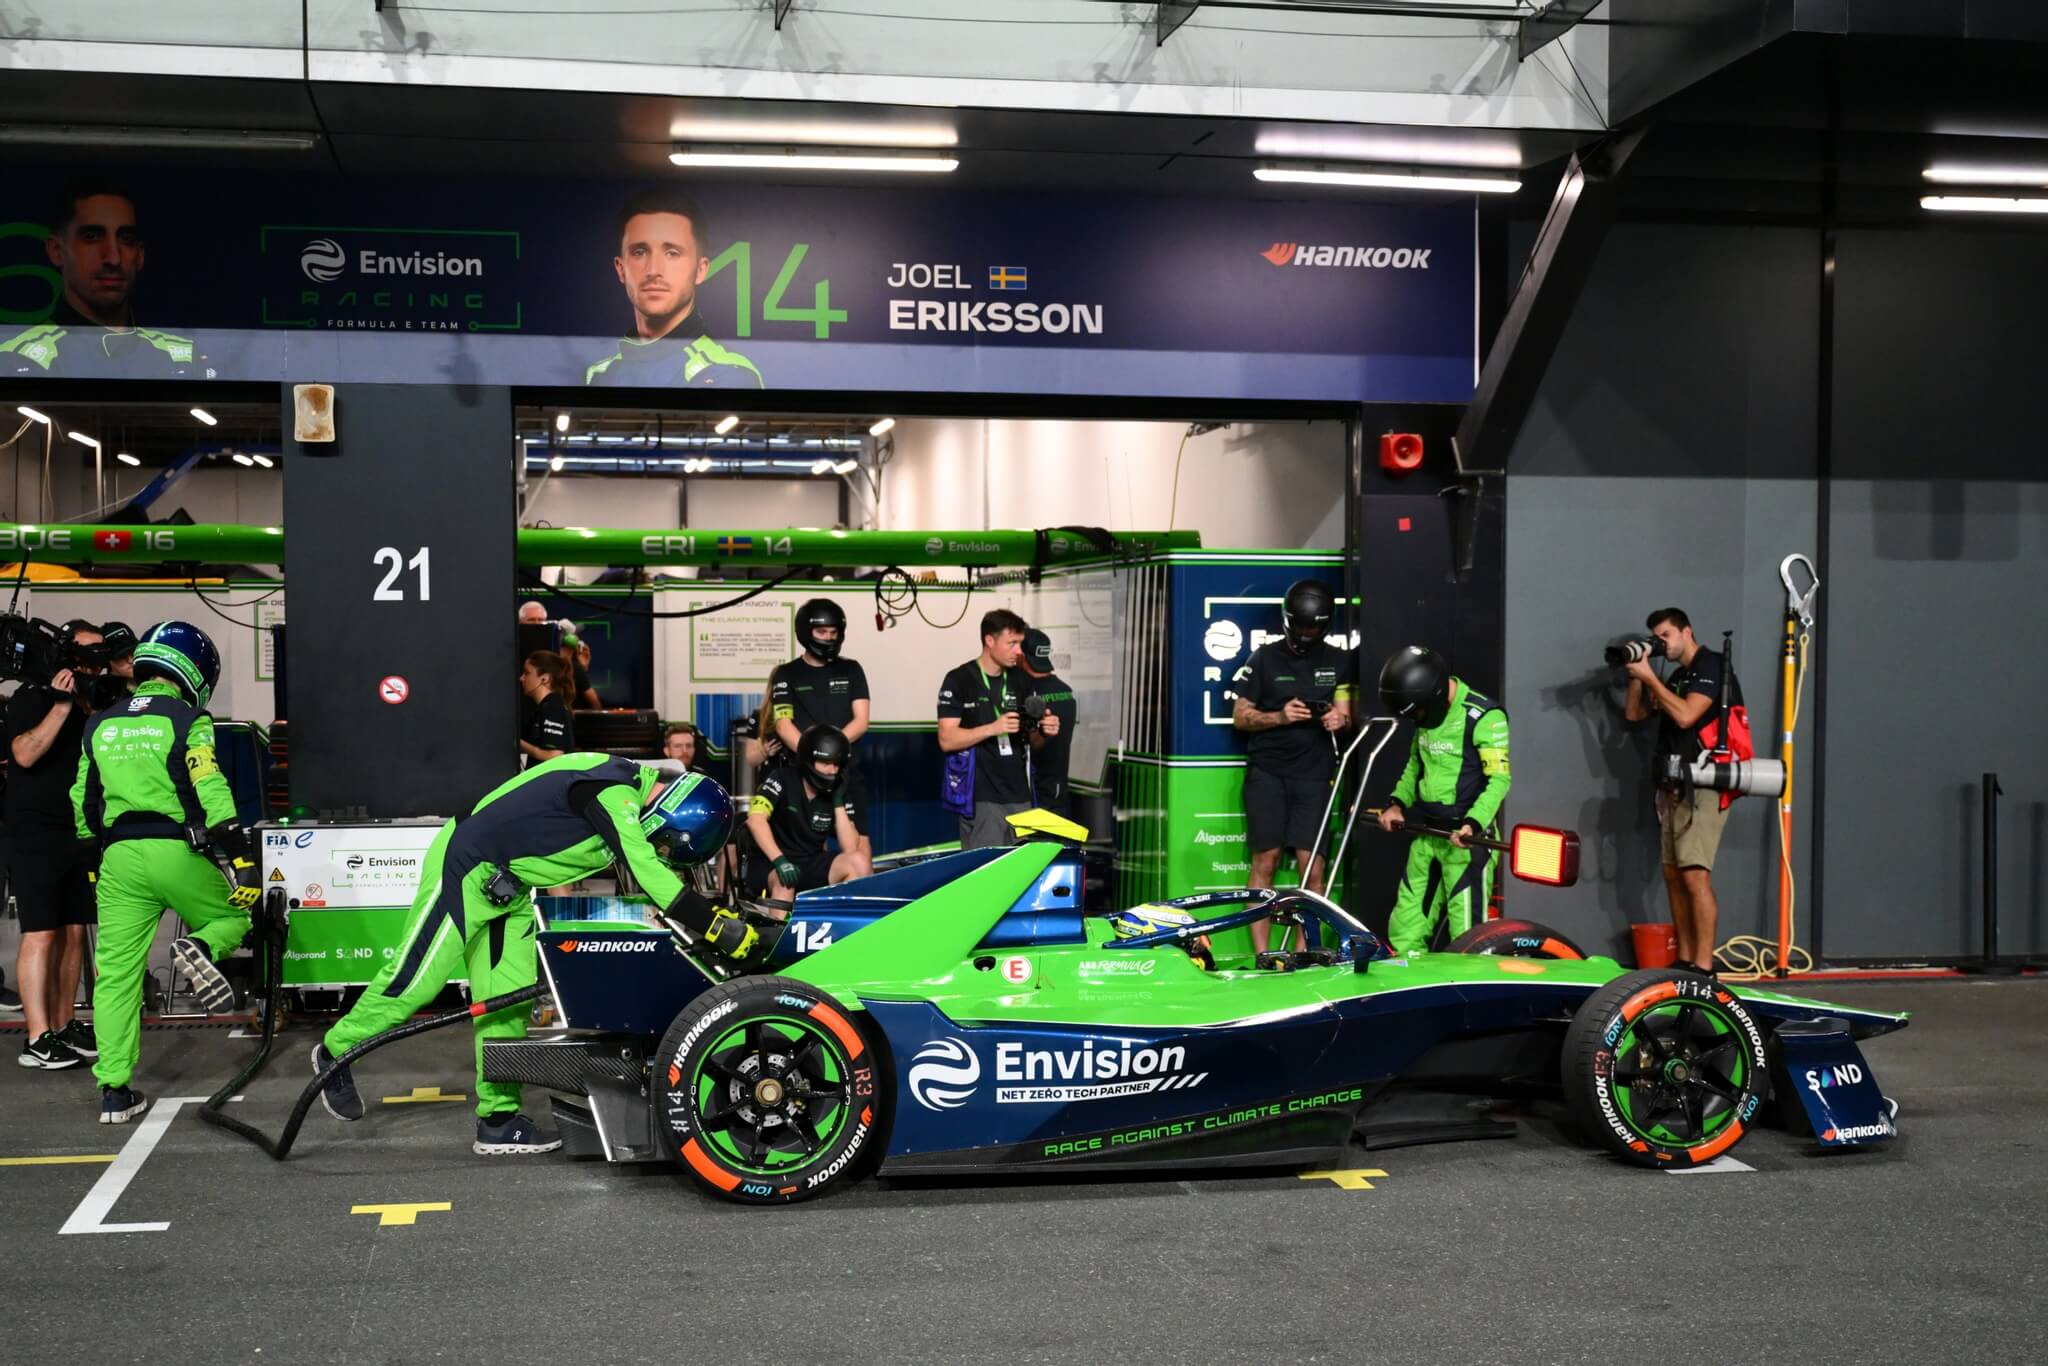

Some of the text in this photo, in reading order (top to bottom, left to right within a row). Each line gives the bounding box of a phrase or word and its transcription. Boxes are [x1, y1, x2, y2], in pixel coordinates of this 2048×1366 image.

[359, 251, 483, 276] Envision
[887, 263, 972, 289] JOEL
[702, 241, 848, 339] 14
[302, 291, 484, 309] RACING
[327, 320, 396, 328] FORMULA
[421, 321, 459, 329] TEAM
[889, 299, 1103, 334] ERIKSSON
[144, 530, 175, 550] 16
[641, 536, 793, 555] ERI 14
[948, 541, 1000, 552] Envision
[373, 546, 430, 601] 21
[1194, 830, 1246, 845] Algorand
[368, 857, 416, 867] Envision
[791, 921, 832, 953] 14
[283, 950, 326, 960] Algorand
[1009, 960, 1023, 979] E
[1675, 980, 1712, 999] #14
[996, 1038, 1186, 1081] Envision
[1001, 1082, 1151, 1099] NET ZERO TECH PARTNER
[1044, 1089, 1362, 1156] RACE AGAINST CLIMATE CHANGE
